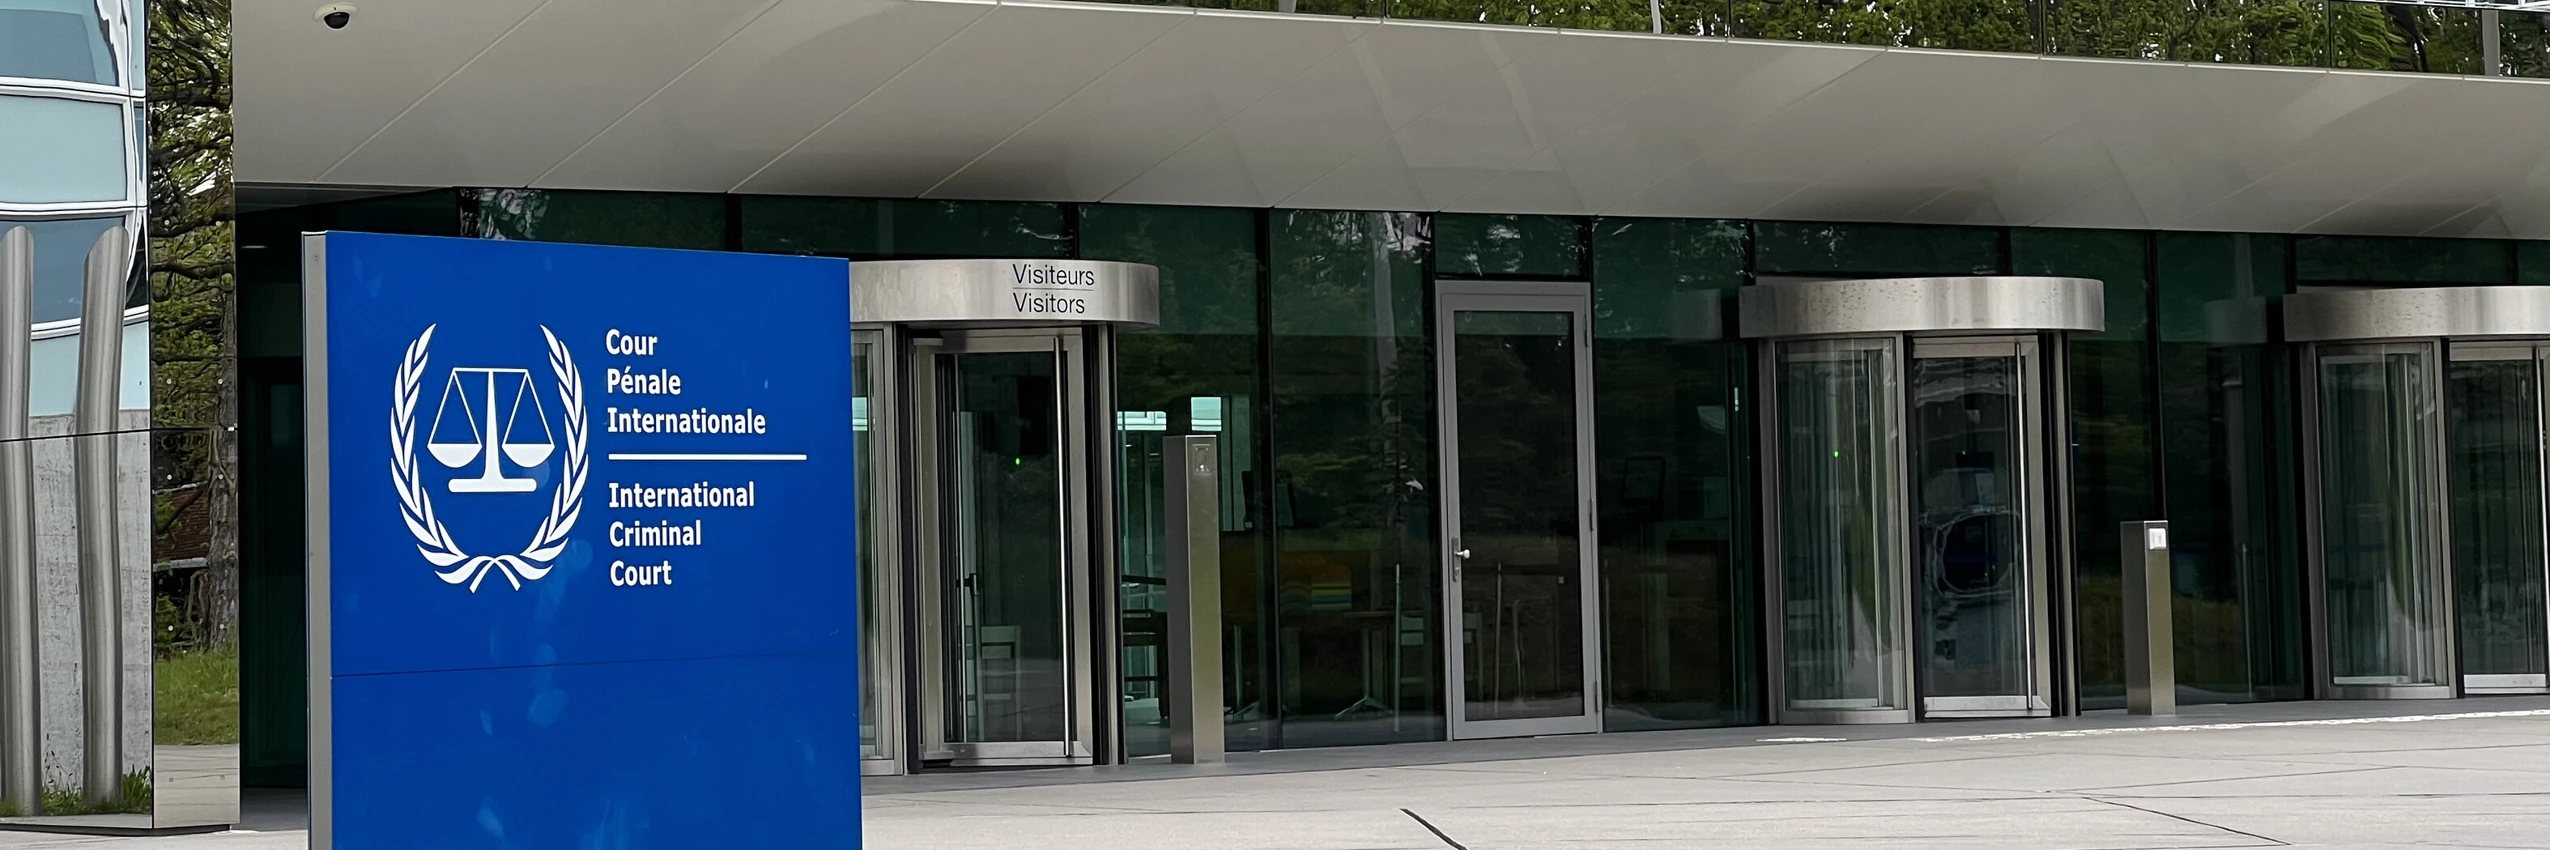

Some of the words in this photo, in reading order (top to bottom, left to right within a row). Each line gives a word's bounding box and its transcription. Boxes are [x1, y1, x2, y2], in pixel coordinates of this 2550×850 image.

[1012, 264, 1095, 286] Visiteurs
[1012, 292, 1086, 314] Visitors
[605, 328, 658, 356] Cour
[607, 365, 681, 395] Pénale
[607, 407, 766, 435] Internationale
[608, 481, 755, 508] International
[609, 519, 702, 548] Criminal
[610, 560, 673, 587] Court
